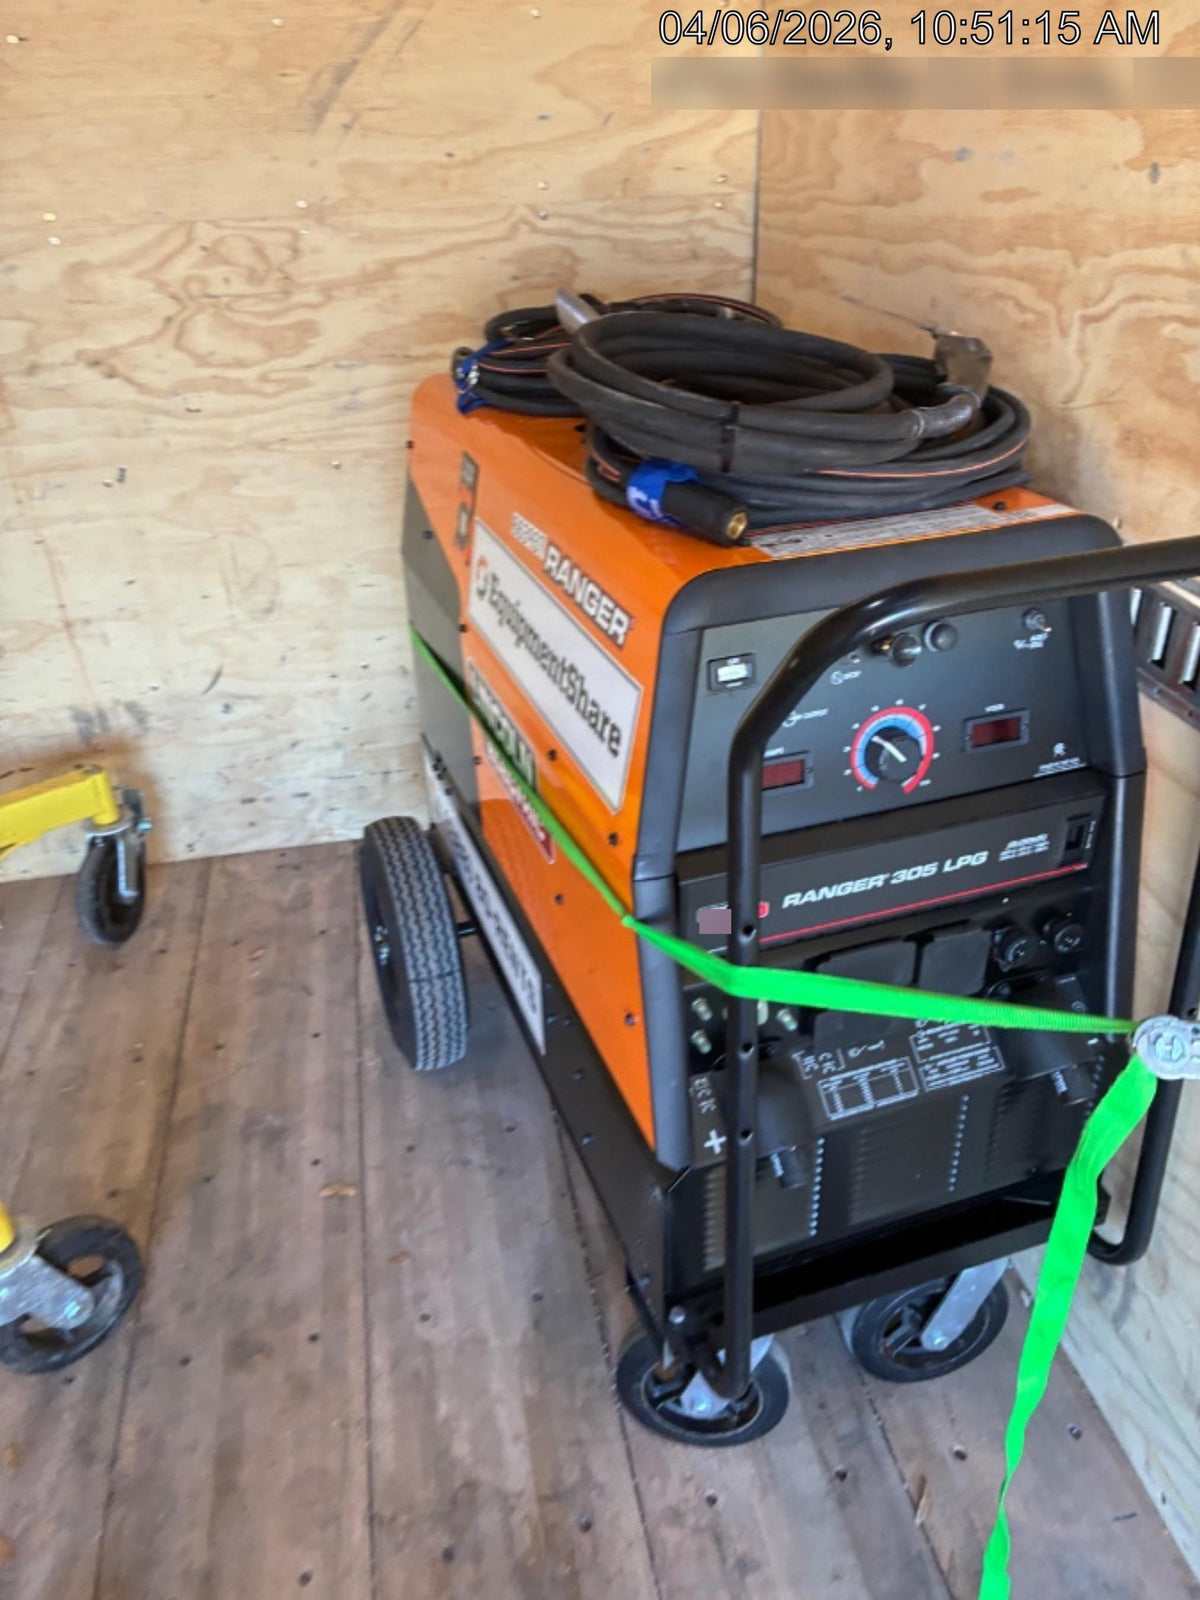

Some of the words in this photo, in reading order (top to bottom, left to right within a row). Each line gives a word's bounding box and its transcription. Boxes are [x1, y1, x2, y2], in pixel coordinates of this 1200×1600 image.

[543, 544, 630, 646] RANGER
[487, 572, 622, 758] EquipmentShare
[890, 862, 939, 885] 305
[943, 851, 989, 873] LPG
